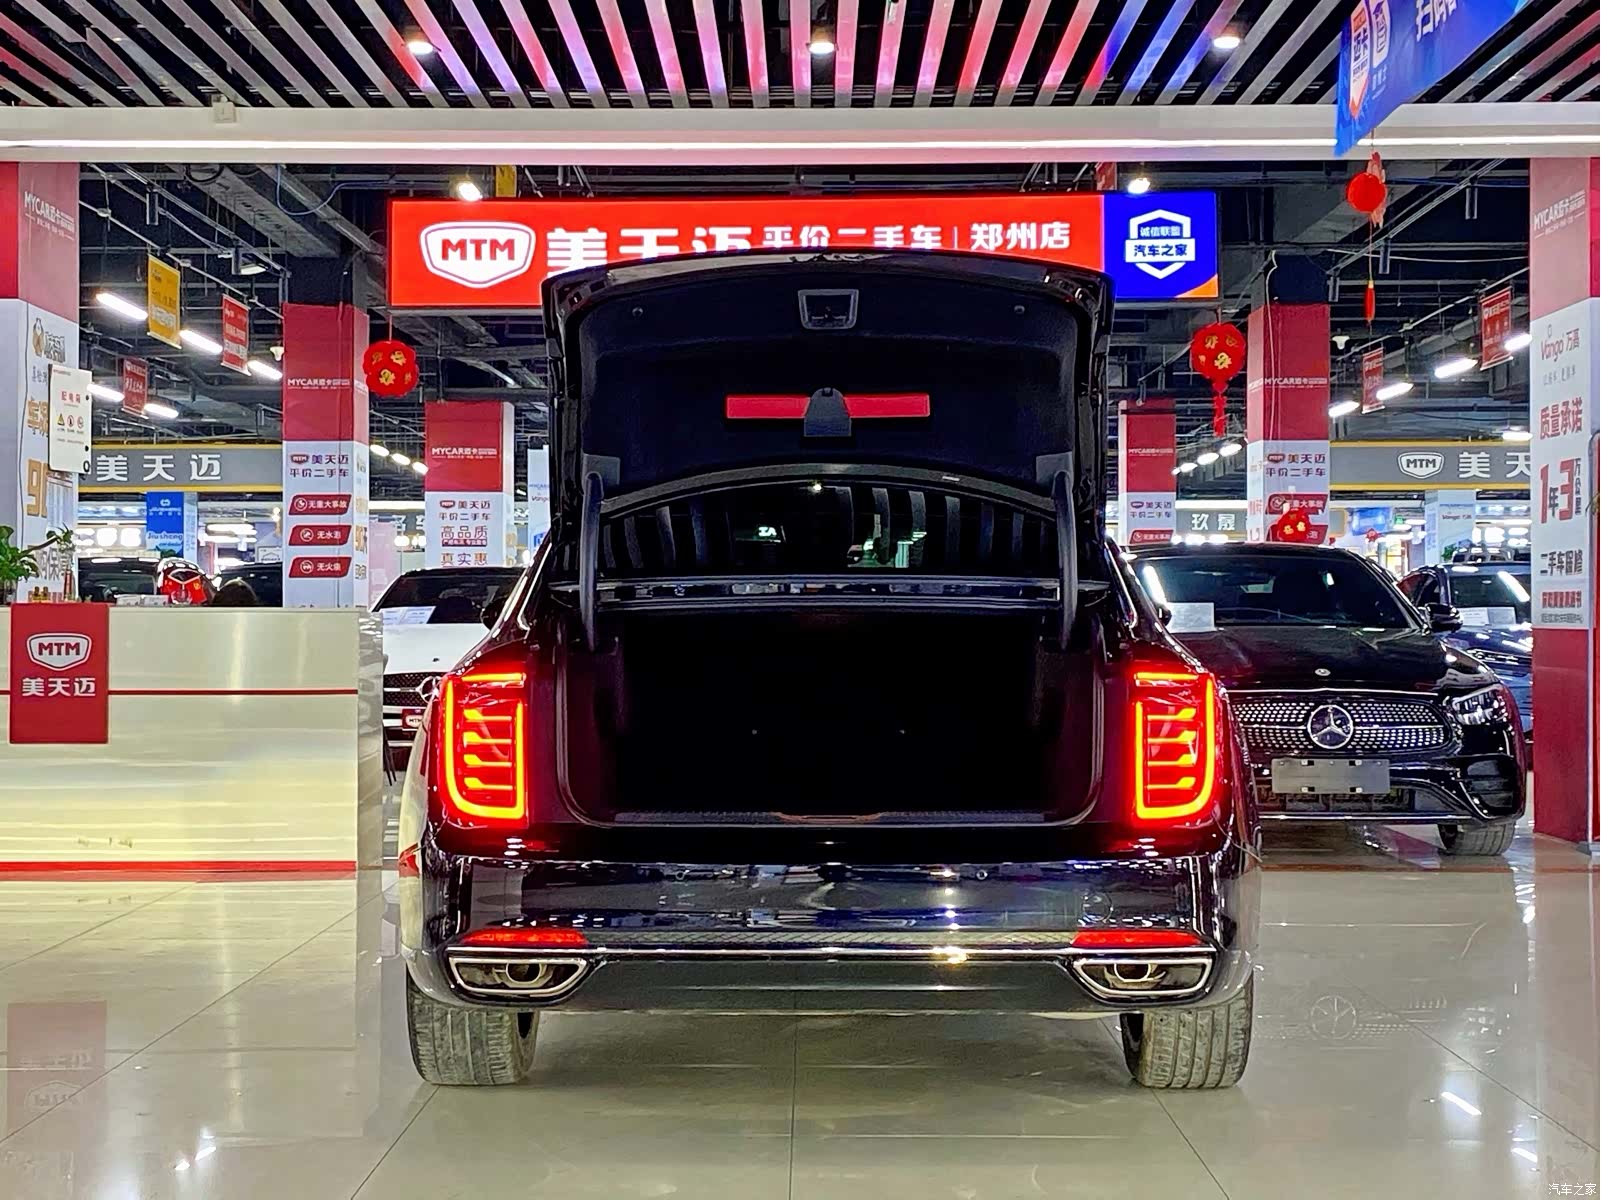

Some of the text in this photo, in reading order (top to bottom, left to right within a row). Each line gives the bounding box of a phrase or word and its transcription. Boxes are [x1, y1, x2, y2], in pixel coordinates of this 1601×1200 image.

[970, 222, 1071, 251] 郑州店
[441, 238, 516, 262] MTM
[1133, 244, 1188, 257] 汽车之家
[1540, 397, 1583, 441] 质量承诺
[311, 454, 349, 465] 美天迈
[1287, 453, 1326, 464] 美天迈
[1406, 457, 1437, 468] MTM
[96, 454, 223, 482] 美天迈
[290, 468, 349, 478] 平价二手车
[1265, 467, 1326, 477] 平价二手车
[308, 500, 348, 509] 无重大事故
[441, 525, 488, 540] 高品质
[441, 552, 488, 566] 真实惠
[38, 642, 81, 656] MTM
[22, 677, 96, 697] 美天迈
